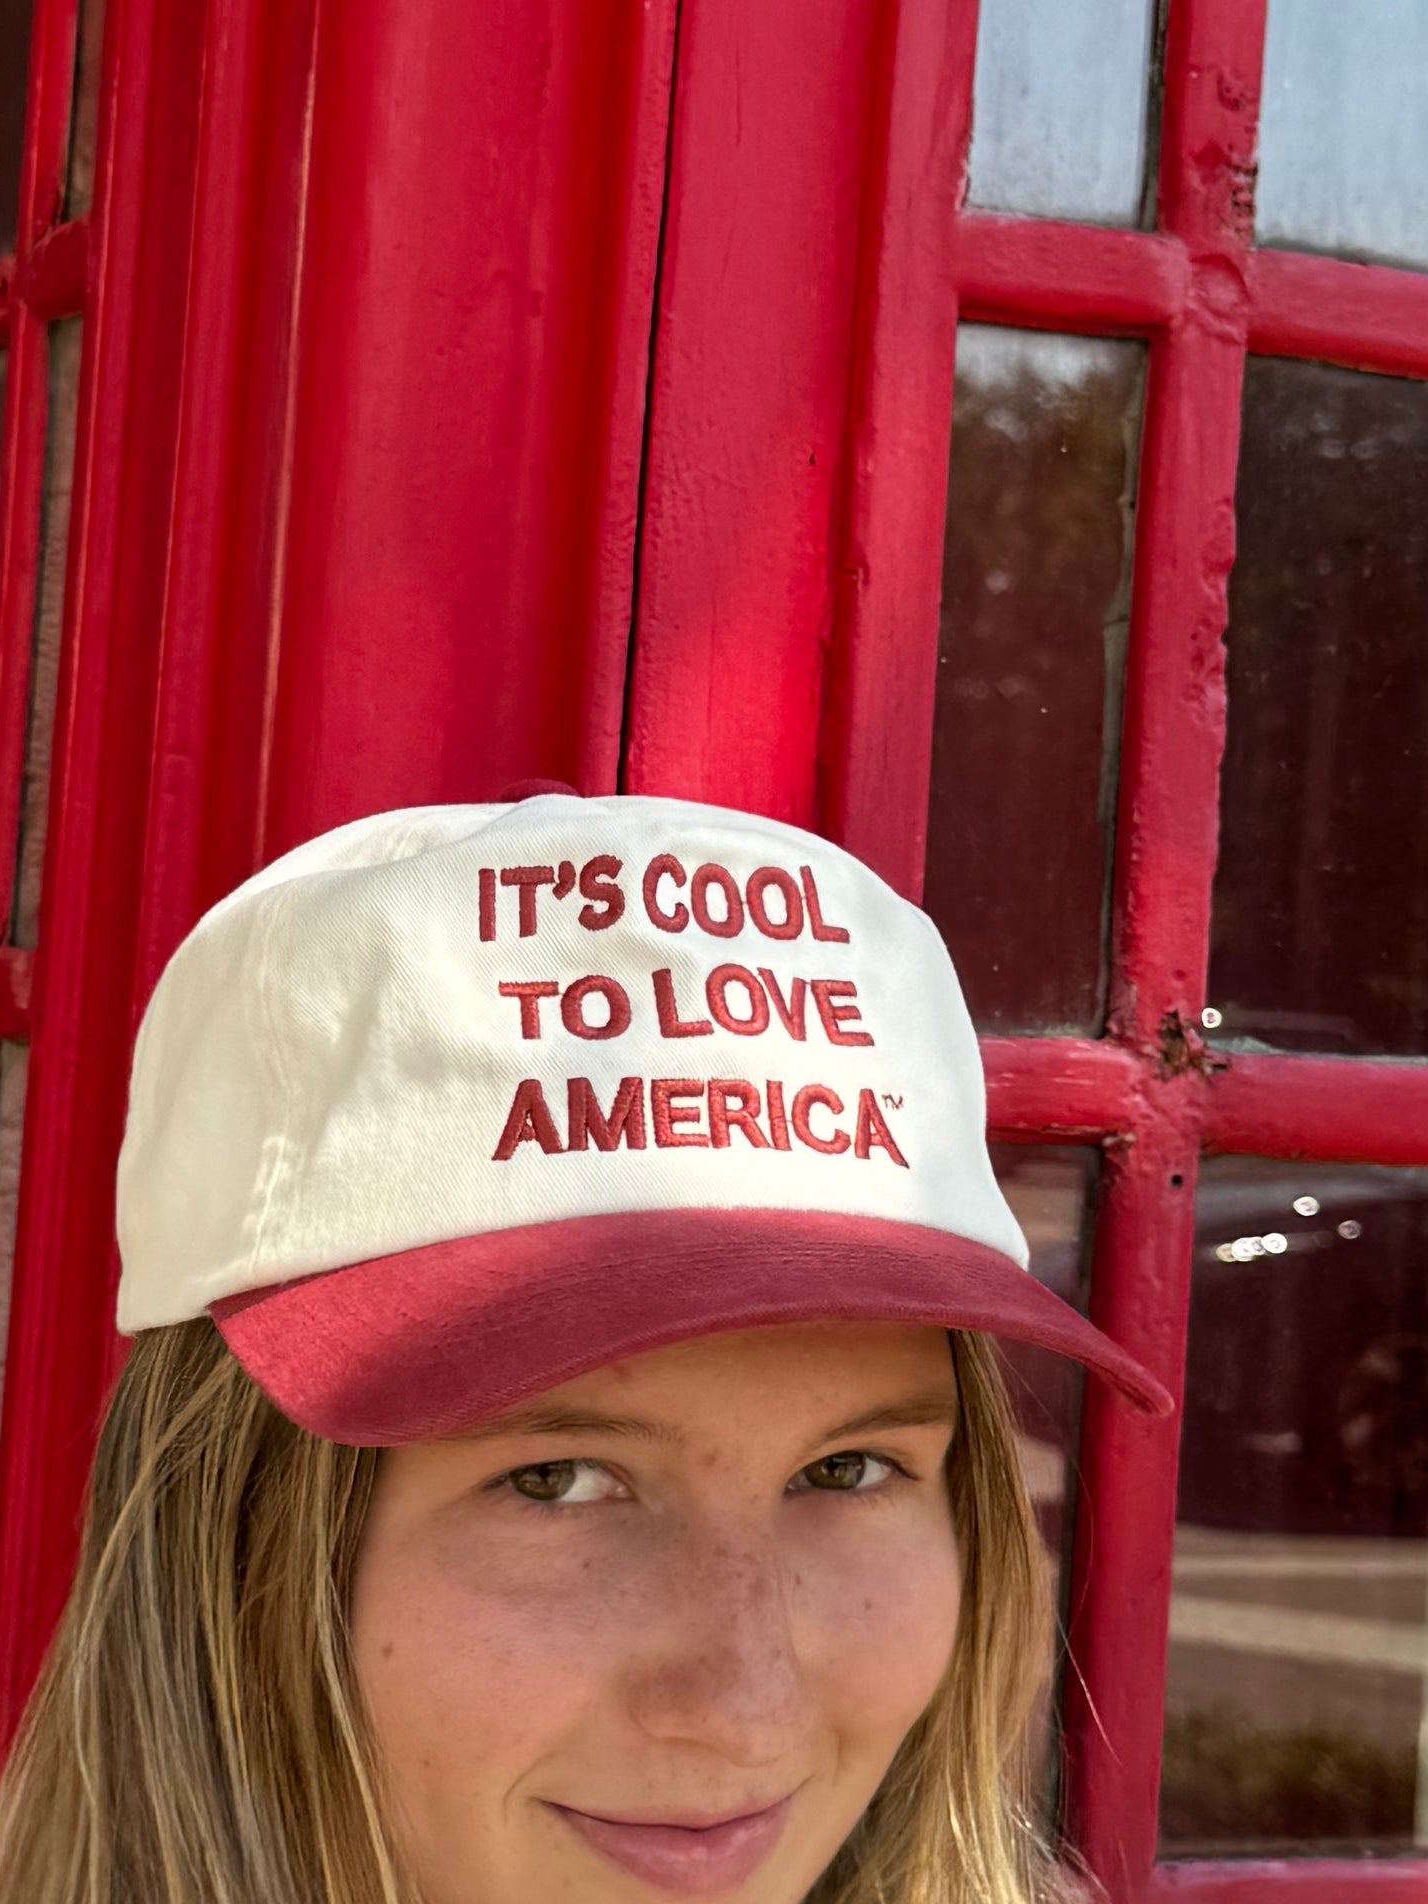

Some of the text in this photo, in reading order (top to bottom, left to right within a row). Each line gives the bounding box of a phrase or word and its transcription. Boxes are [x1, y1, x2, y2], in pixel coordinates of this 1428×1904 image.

[478, 853, 851, 944] IT'S COOL
[498, 962, 876, 1047] TO LOVE
